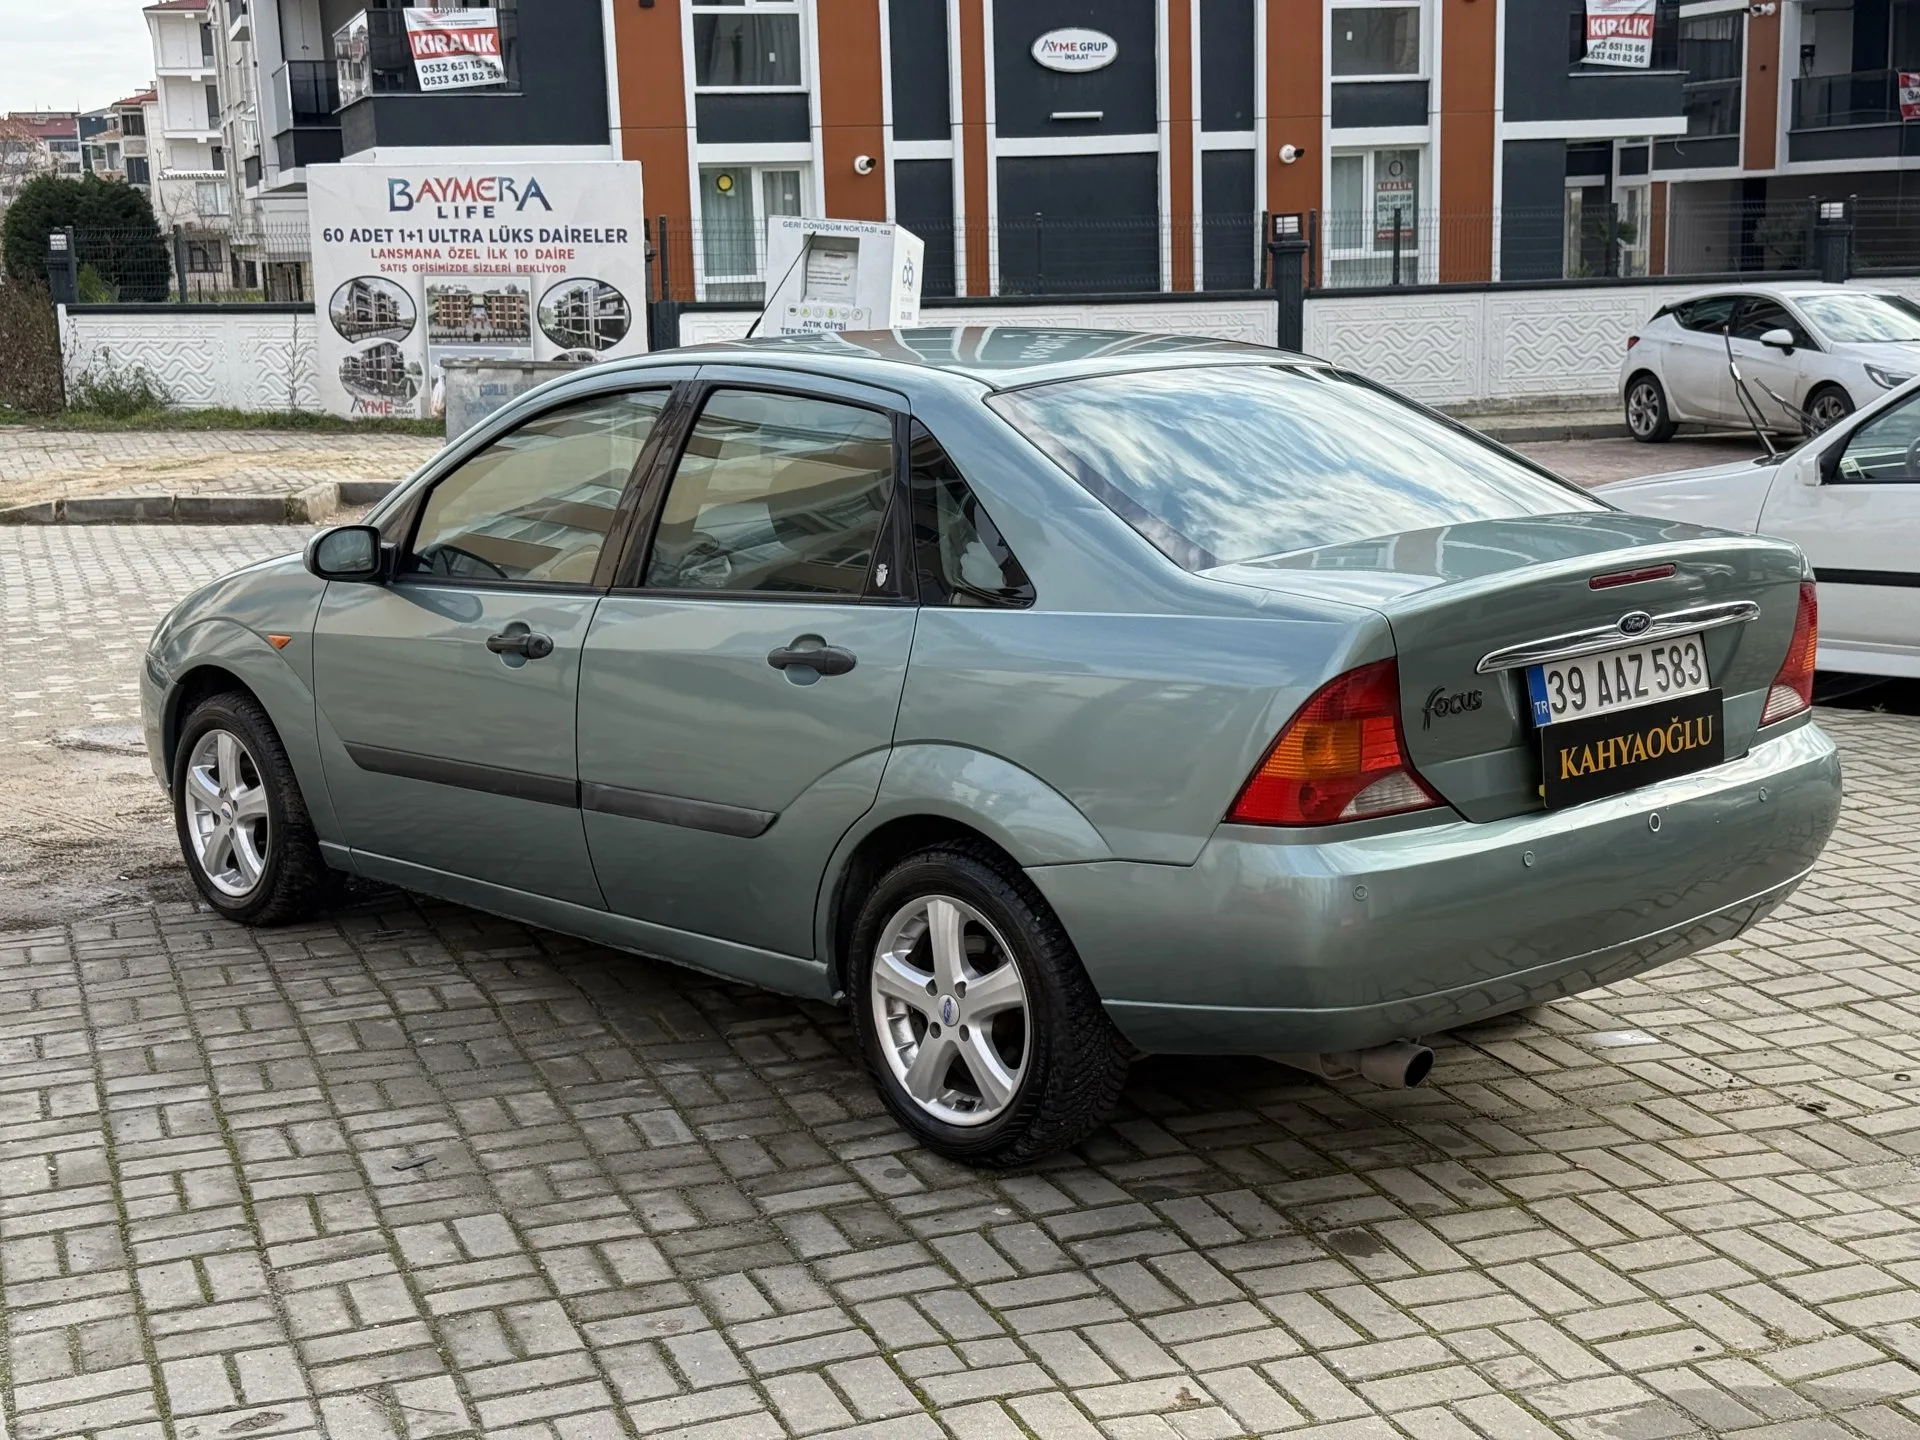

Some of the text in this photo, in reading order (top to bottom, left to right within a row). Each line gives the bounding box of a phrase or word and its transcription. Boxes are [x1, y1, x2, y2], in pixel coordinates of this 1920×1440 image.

[1041, 39, 1108, 52] AYME GRUP
[1064, 53, 1089, 61] İNŞAAT
[421, 64, 449, 74] 0532
[451, 62, 469, 71] 651
[470, 61, 482, 69] 15
[423, 70, 500, 86] 0533 431 82 56
[387, 176, 553, 212] BAYMERA
[437, 205, 496, 219] LIFE
[323, 224, 628, 244] 60 ADET 1+1 ULTRA LÜKS DAİRELER
[370, 246, 575, 260] LANSMANA ÖZEL İLK 10 DAİRE
[380, 263, 408, 274] SATIŞ
[516, 262, 567, 274] BEKLİYOR
[802, 320, 822, 328] ATIK
[350, 395, 393, 414] AYME
[1625, 616, 1648, 630] Ford
[1547, 642, 1703, 714] 39 AAZ 583
[1534, 700, 1549, 715] TR
[1559, 715, 1714, 781] KAHYAOĞLU
